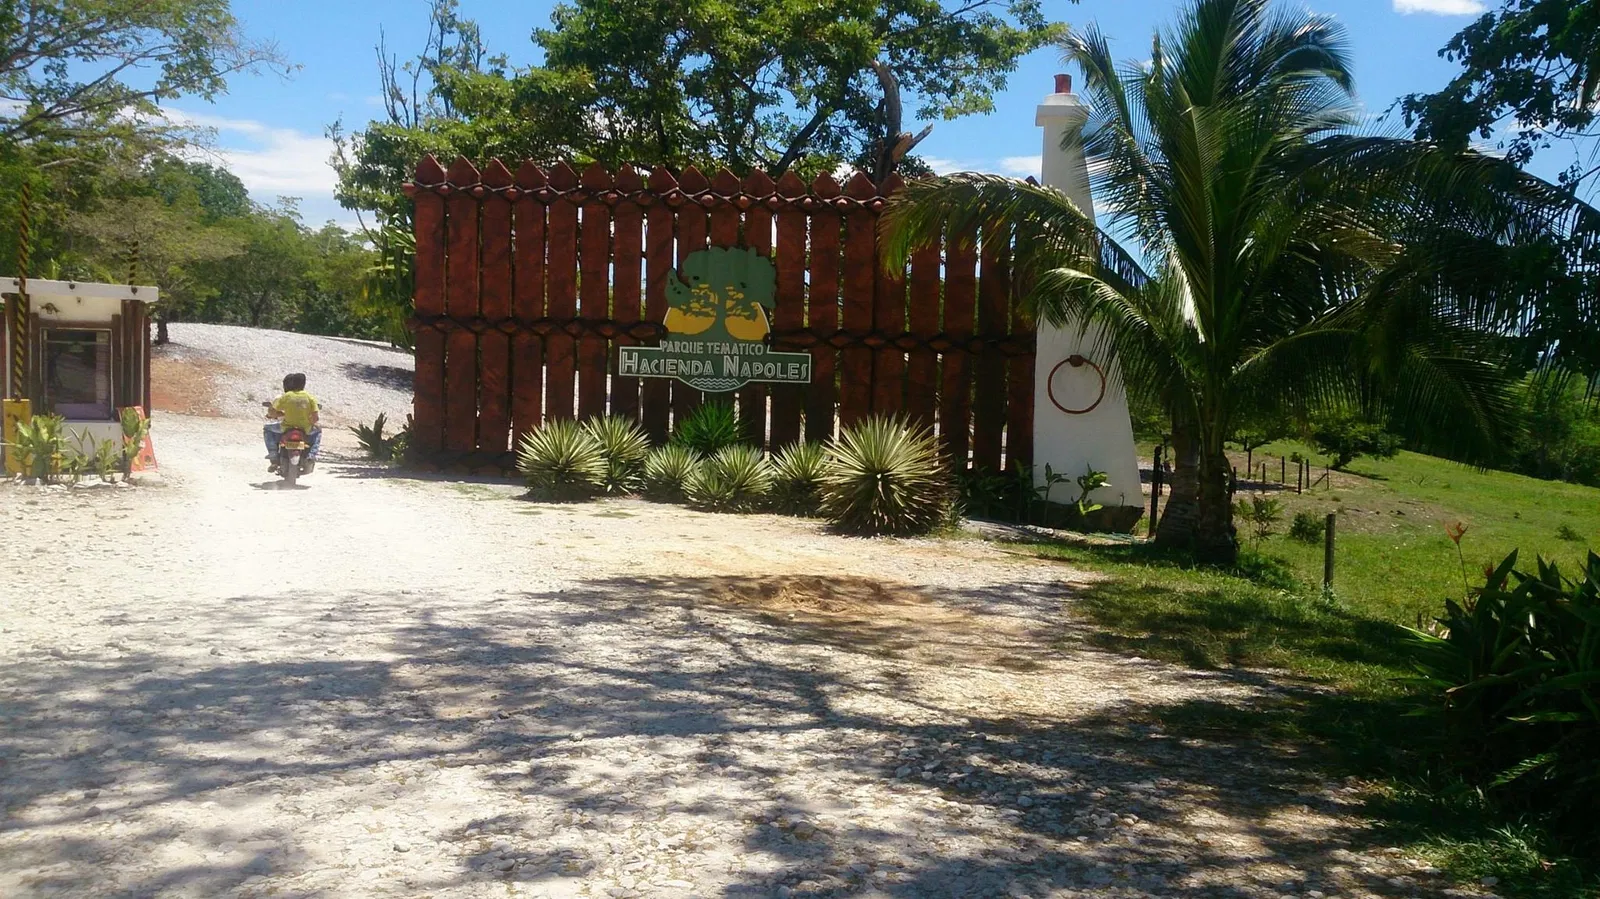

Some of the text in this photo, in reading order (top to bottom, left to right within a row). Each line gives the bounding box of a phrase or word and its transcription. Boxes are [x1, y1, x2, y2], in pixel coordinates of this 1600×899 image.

[662, 340, 764, 356] PARQUE TEMATICO
[621, 351, 808, 380] HACIENDA NAPOLES
